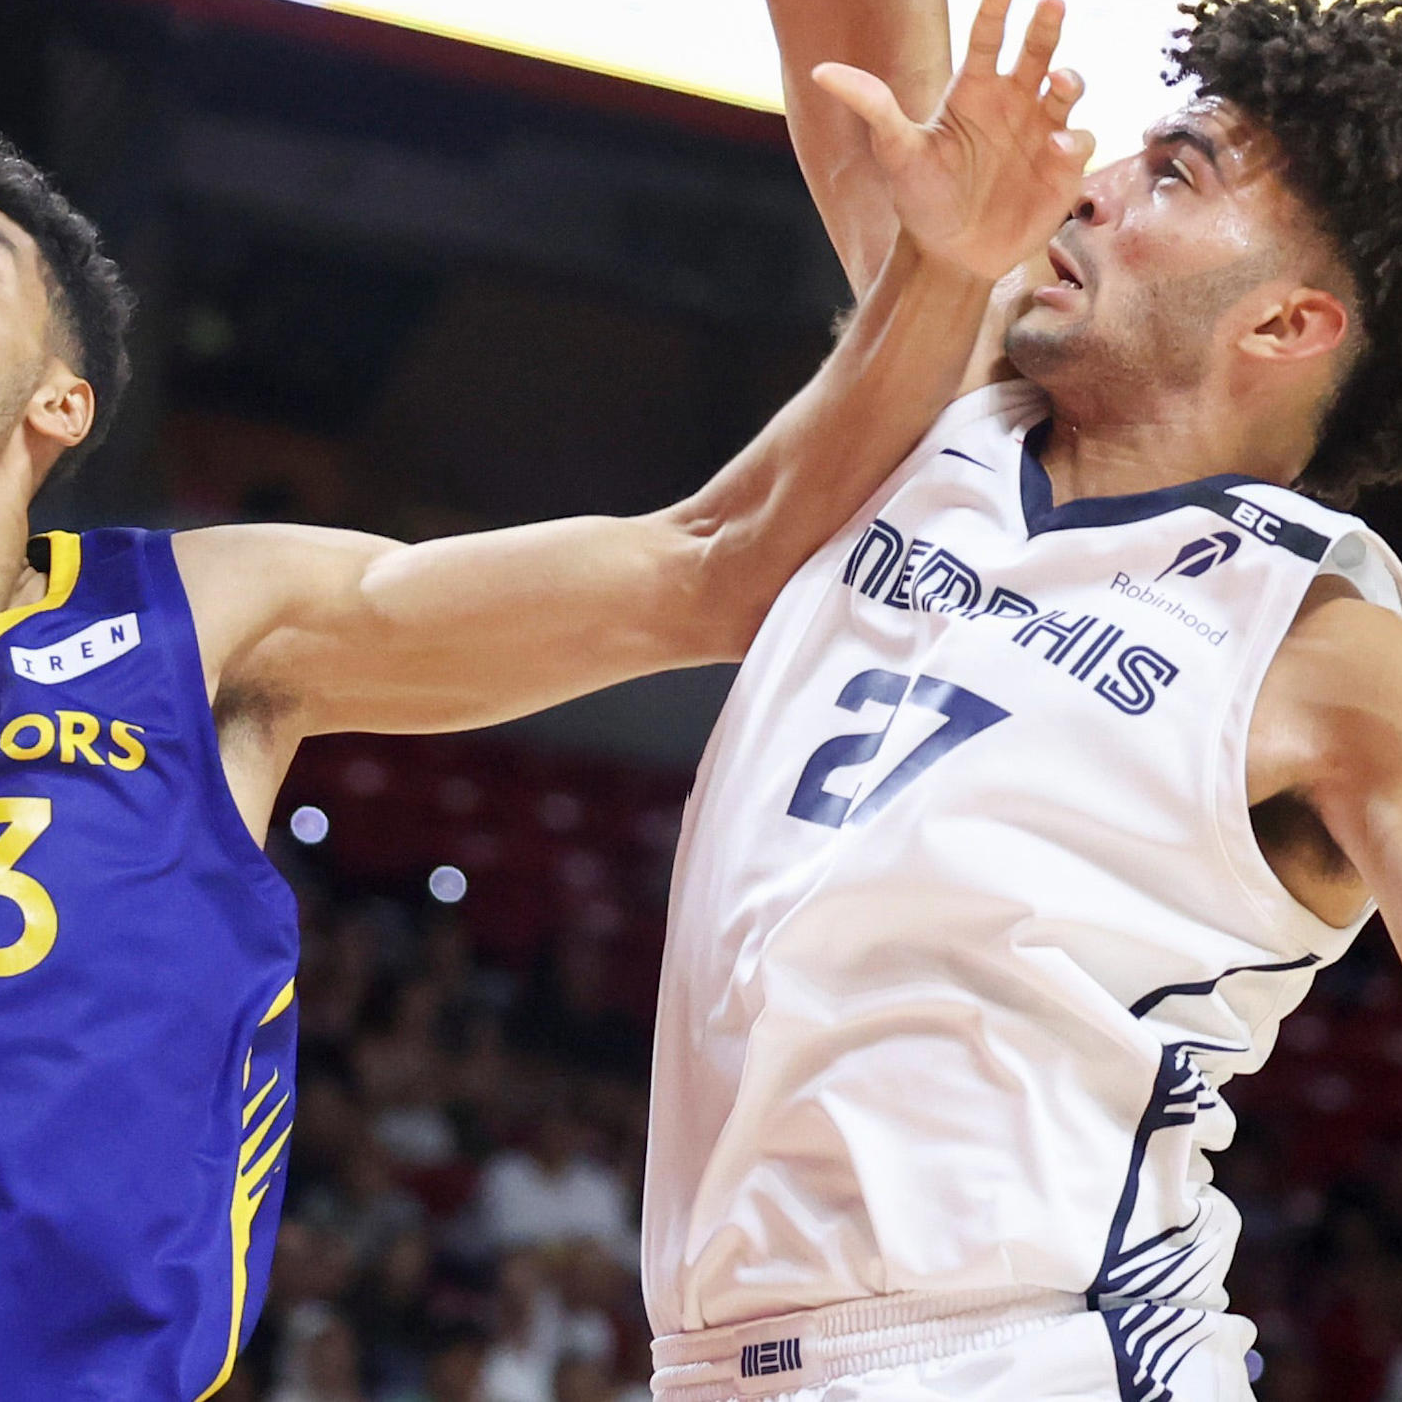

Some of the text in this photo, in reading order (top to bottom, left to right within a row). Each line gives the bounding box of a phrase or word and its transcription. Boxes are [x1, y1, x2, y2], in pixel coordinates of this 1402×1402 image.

[1231, 501, 1282, 543] BC
[842, 518, 1180, 716] MEMPHIS
[1109, 571, 1229, 646] Robinhood
[22, 624, 125, 675] IREN
[786, 668, 1013, 829] 27
